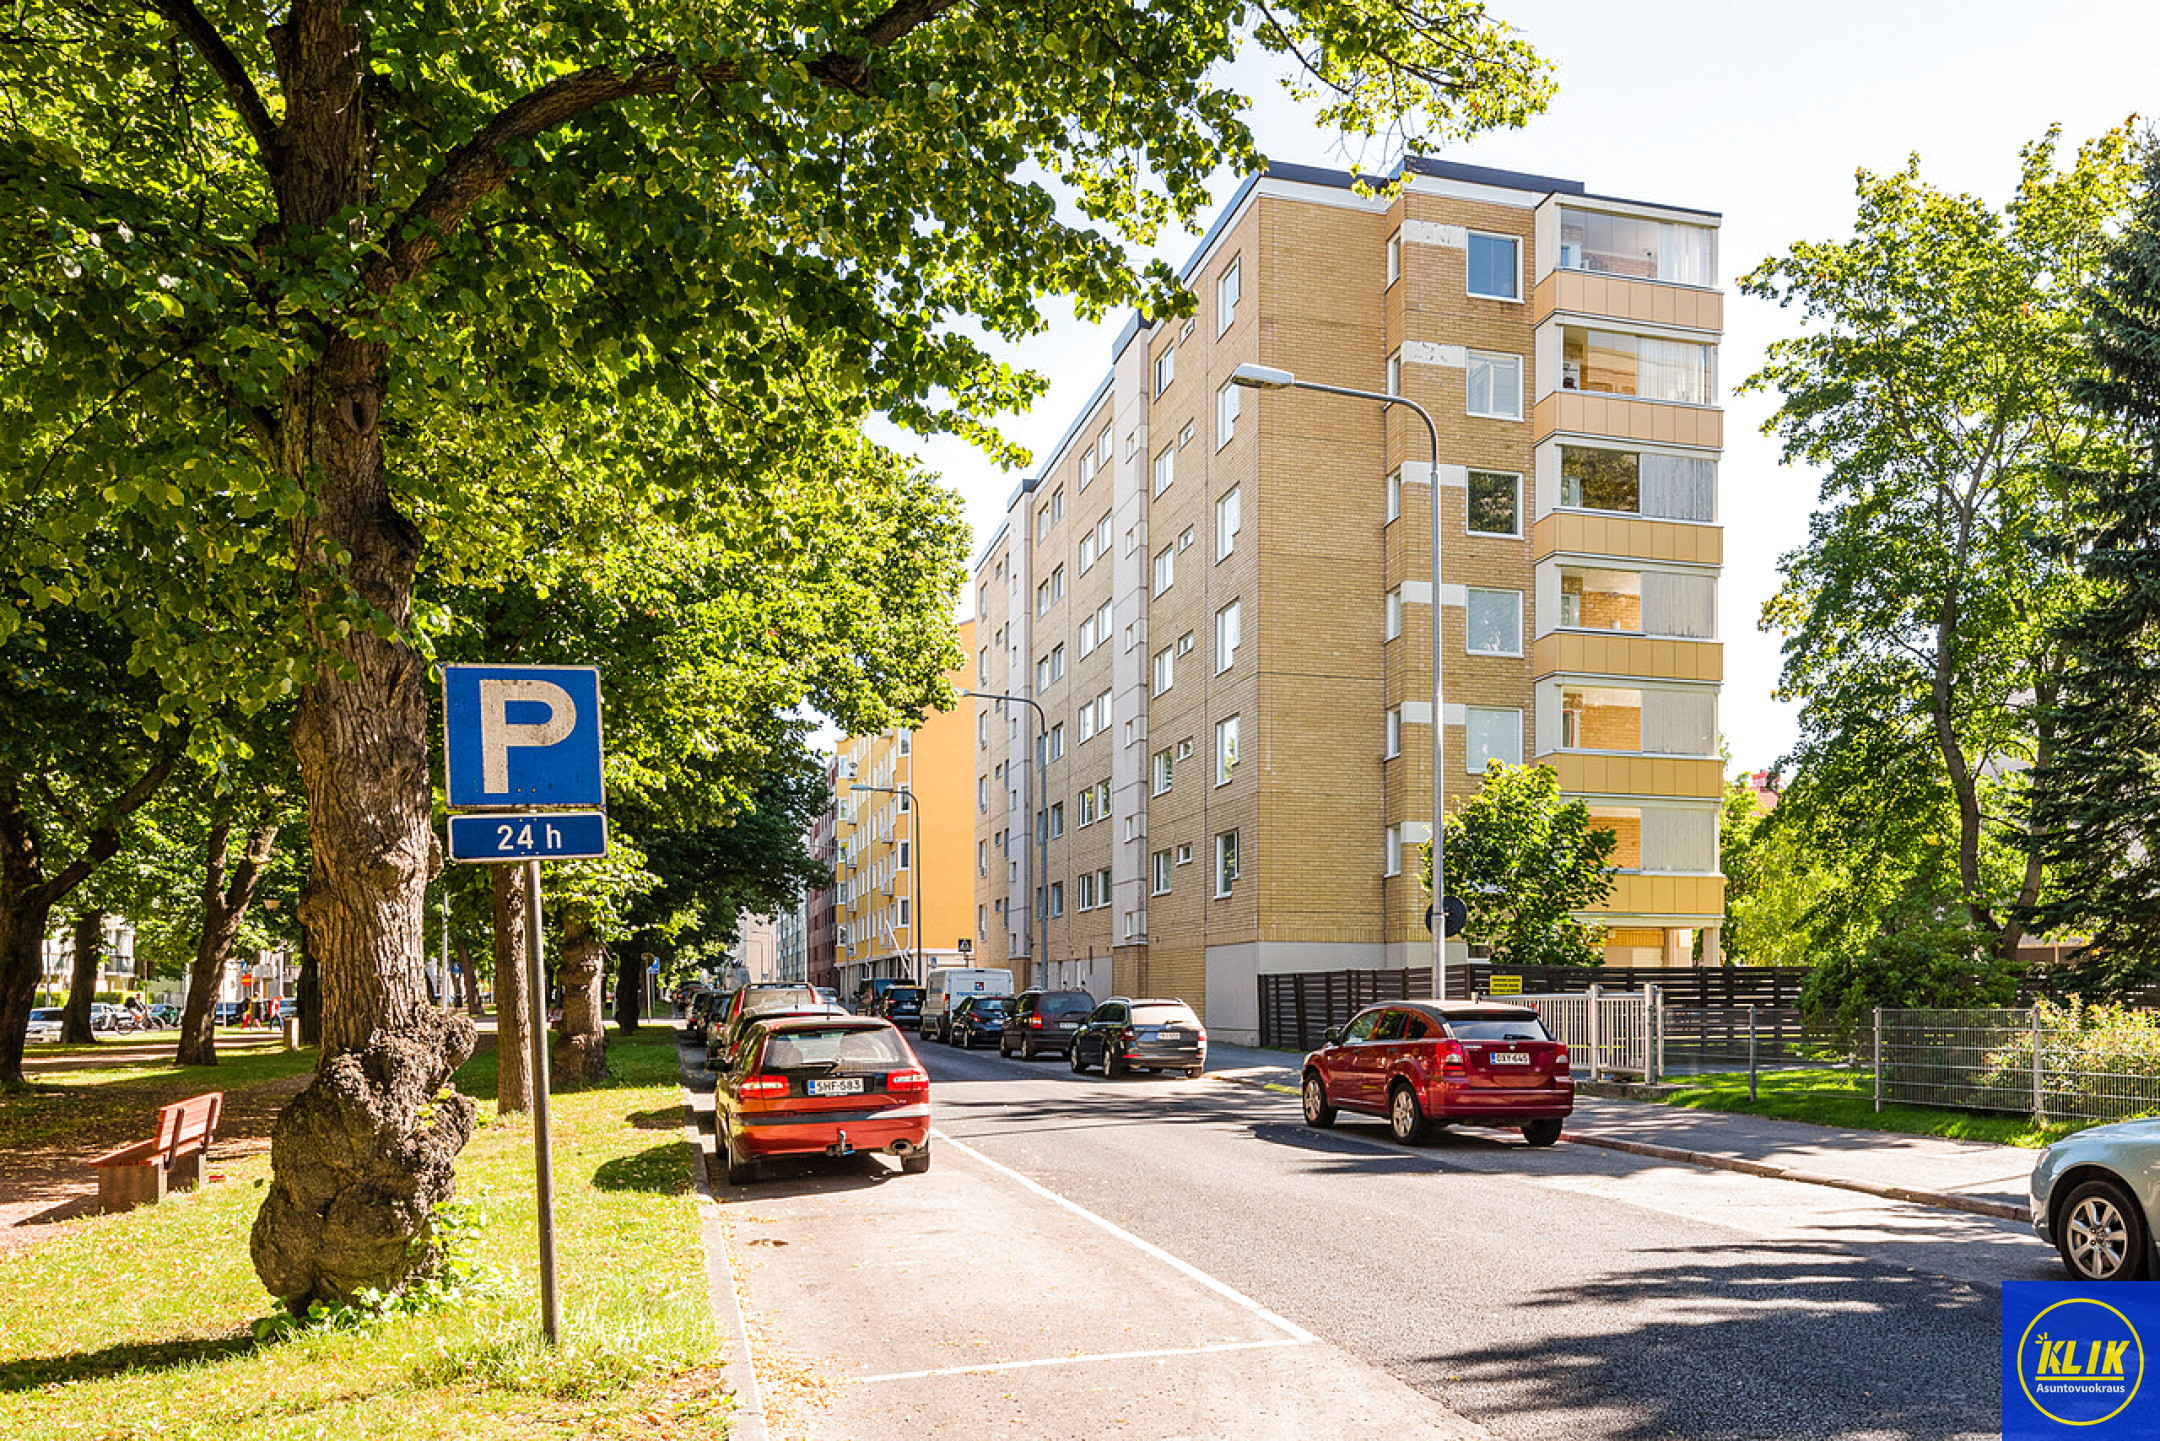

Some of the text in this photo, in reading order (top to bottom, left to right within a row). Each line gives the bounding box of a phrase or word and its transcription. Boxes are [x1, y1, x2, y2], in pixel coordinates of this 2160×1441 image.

[478, 679, 577, 794] P
[497, 823, 563, 851] 24 h
